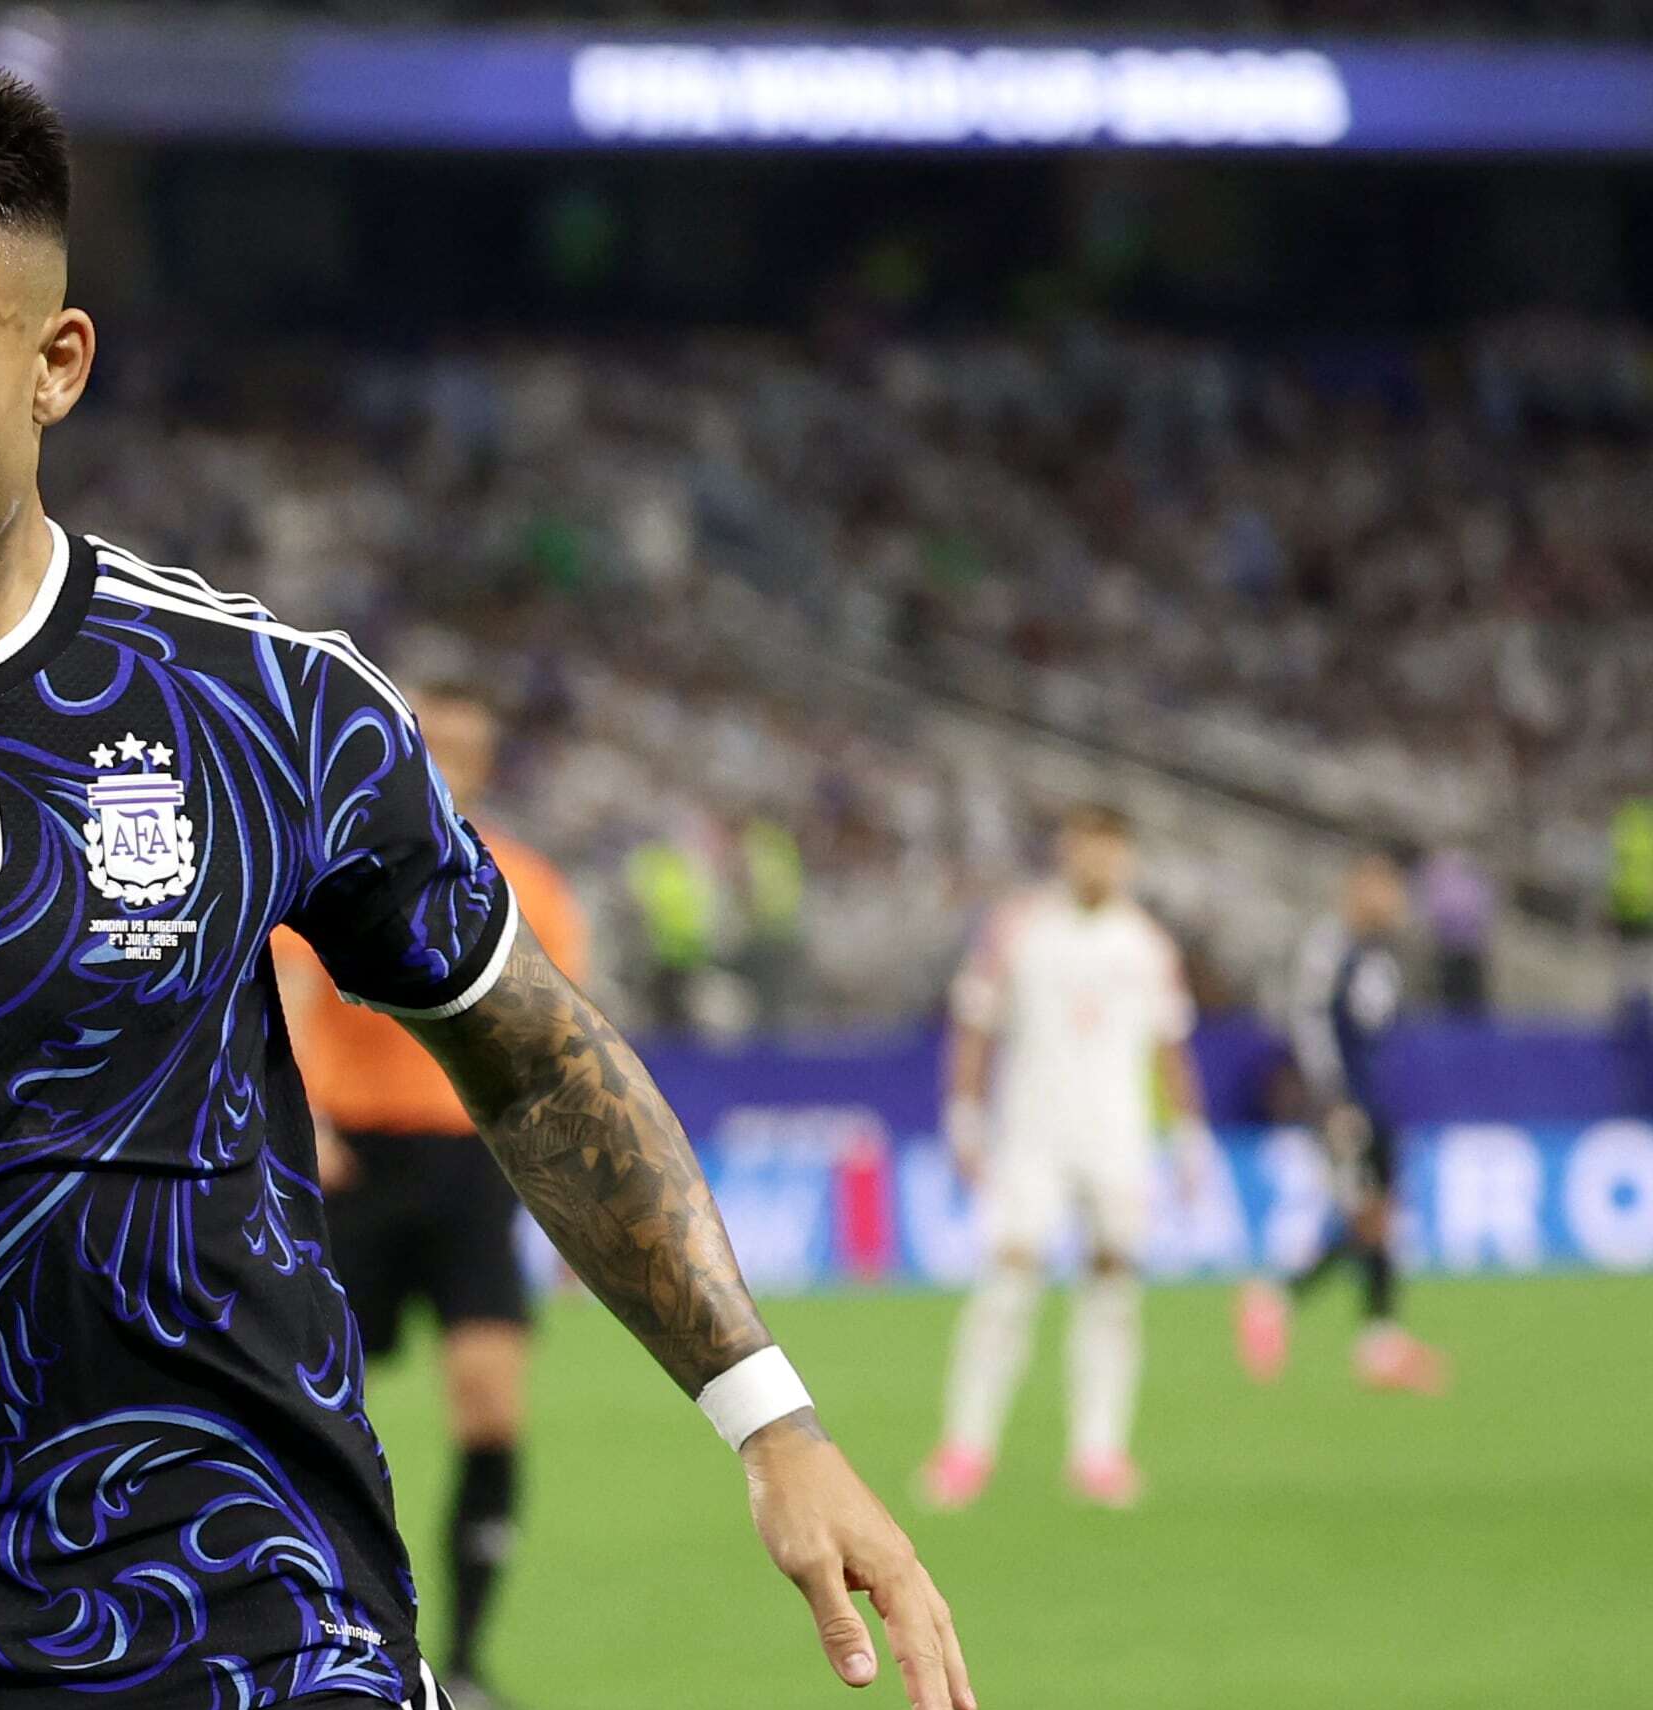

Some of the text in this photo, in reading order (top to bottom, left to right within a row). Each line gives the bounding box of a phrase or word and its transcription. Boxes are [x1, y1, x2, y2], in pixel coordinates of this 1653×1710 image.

[88, 919, 198, 933] JORDAN VS ARGENTINA
[108, 933, 179, 947] 27 JUNE 2026
[125, 947, 162, 960] DALLAS
